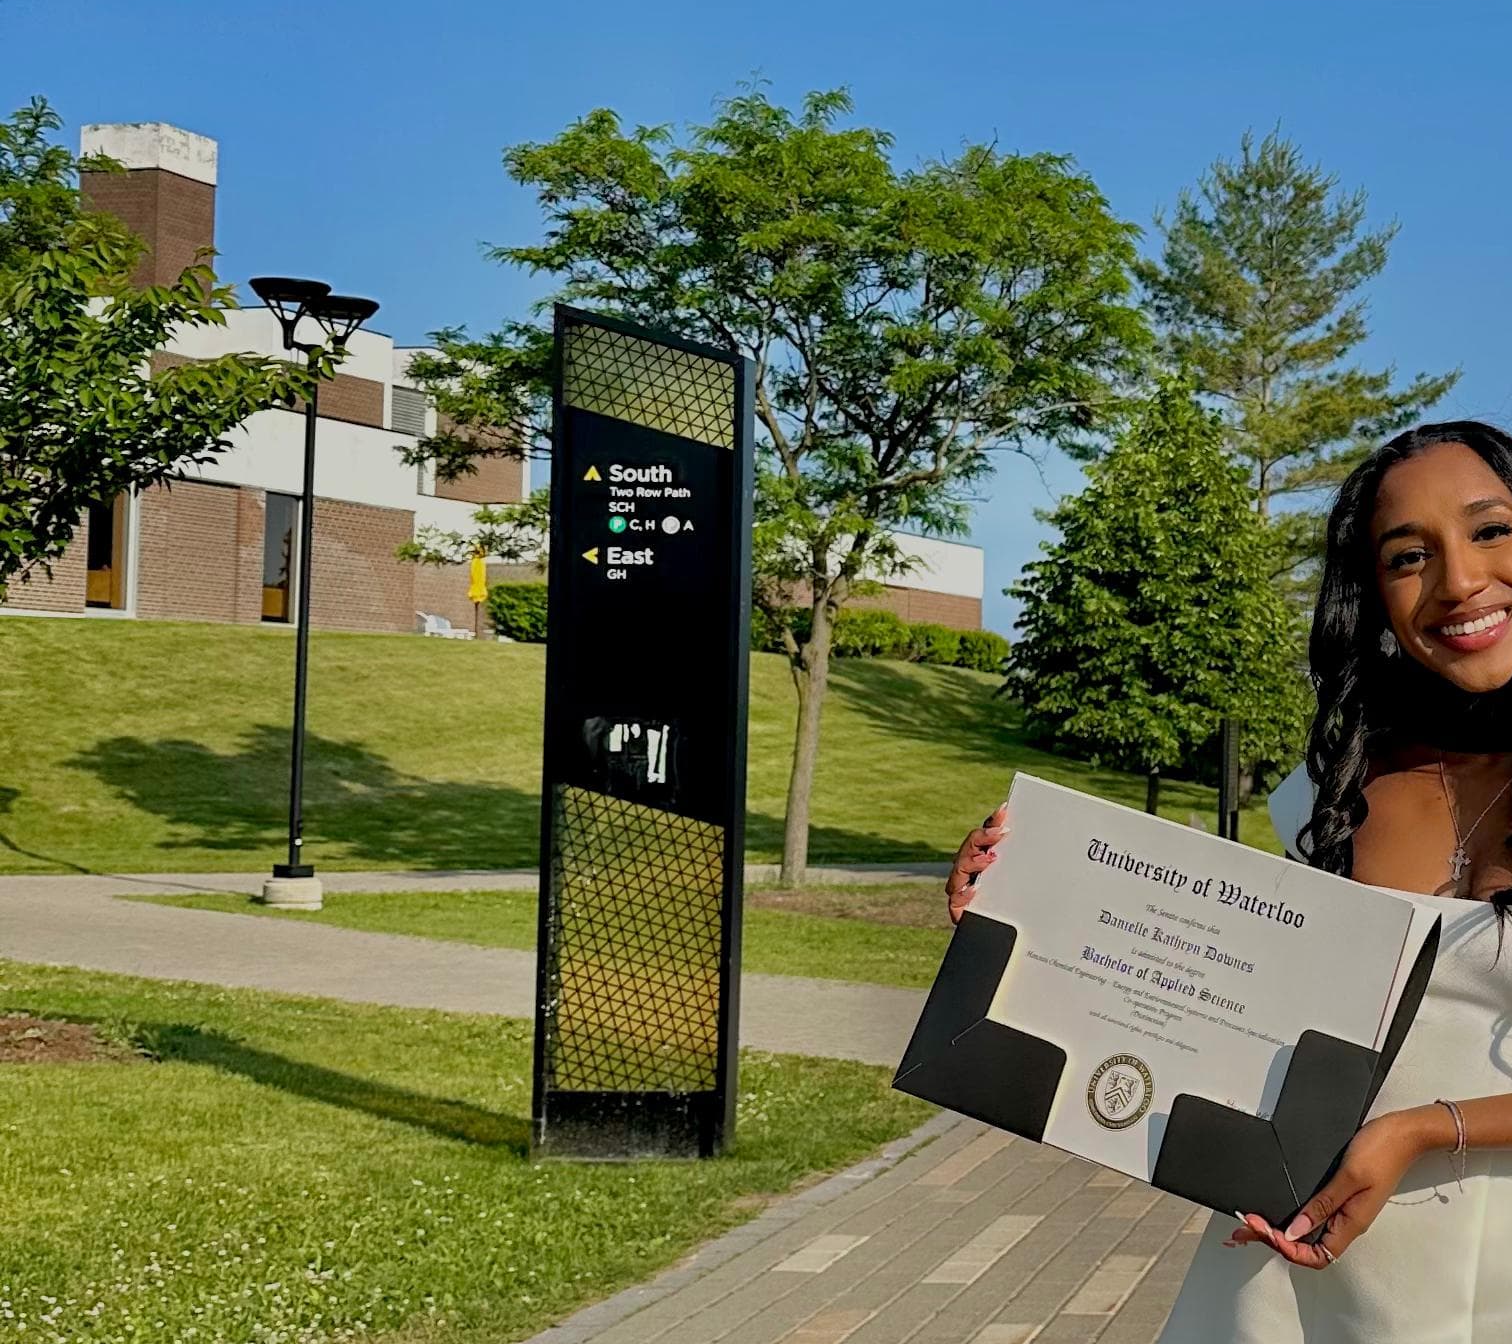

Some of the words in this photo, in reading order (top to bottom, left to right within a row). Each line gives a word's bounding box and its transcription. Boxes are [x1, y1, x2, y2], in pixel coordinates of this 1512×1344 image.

[609, 464, 673, 483] South
[609, 486, 634, 497] Two
[636, 487, 662, 498] Row
[664, 487, 691, 498] Path
[608, 501, 635, 513] SCH
[629, 518, 643, 532] C,
[645, 519, 656, 531] H
[683, 520, 695, 531] A
[607, 546, 654, 565] East
[607, 569, 627, 580] GH
[1087, 838, 1188, 893] University
[1192, 878, 1213, 898] of
[1217, 880, 1305, 928] Waterloo
[1098, 909, 1149, 937] Danielle
[1151, 926, 1201, 955] Kathryn
[1203, 945, 1255, 973] Downes
[1080, 945, 1134, 975] Bachelor
[1135, 967, 1150, 980] of
[1150, 970, 1196, 997] Applied
[1197, 987, 1246, 1014] Science
